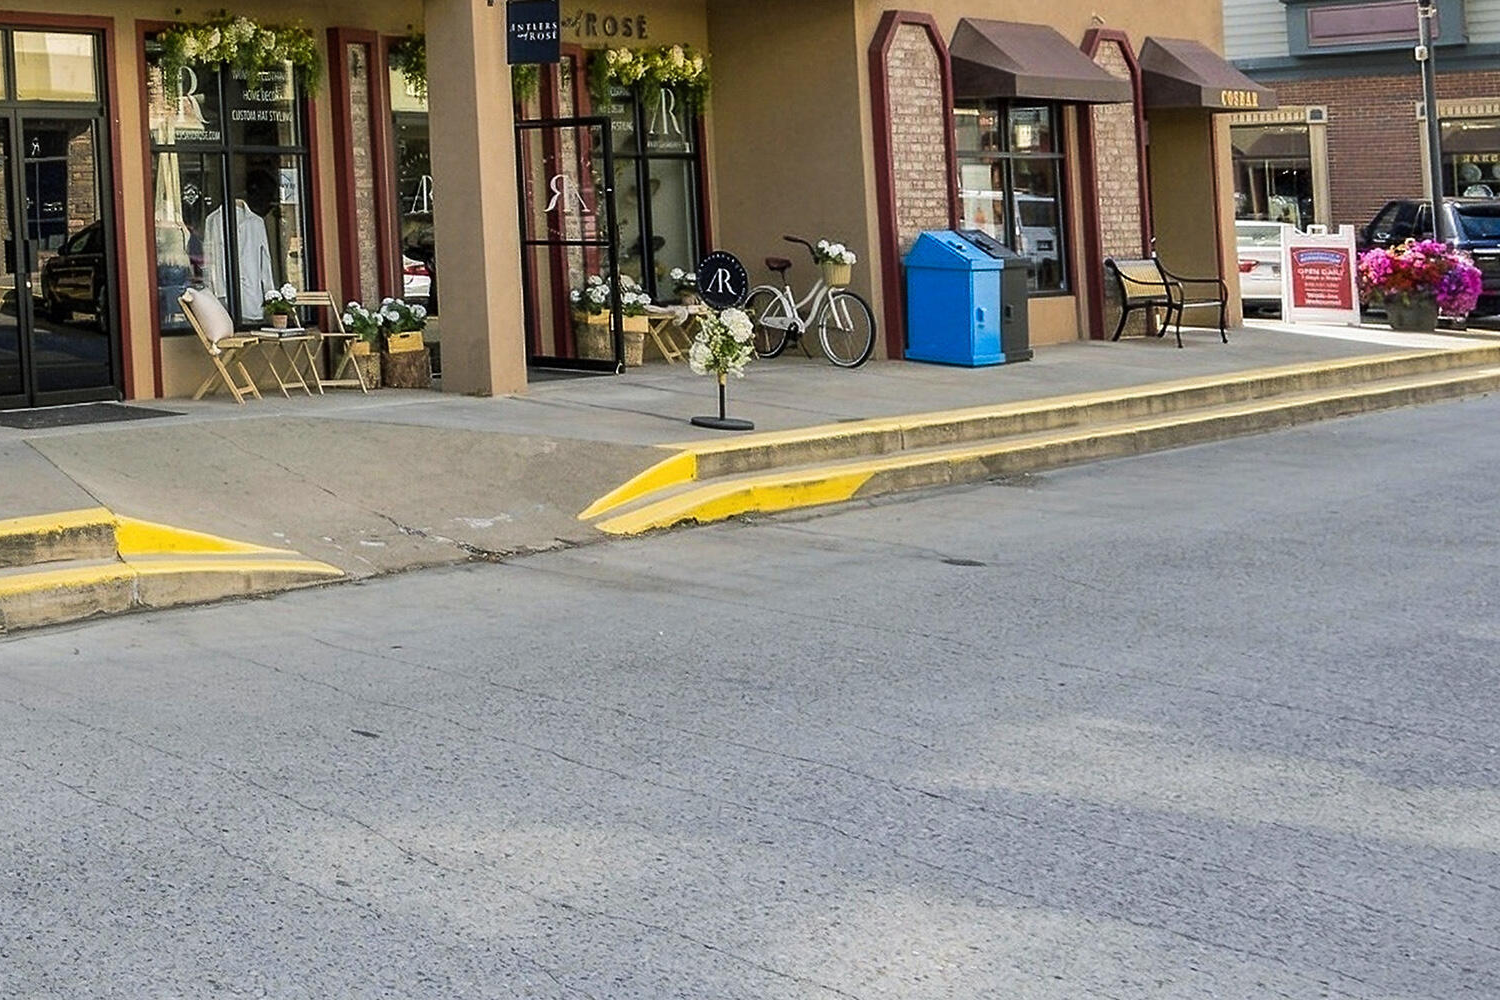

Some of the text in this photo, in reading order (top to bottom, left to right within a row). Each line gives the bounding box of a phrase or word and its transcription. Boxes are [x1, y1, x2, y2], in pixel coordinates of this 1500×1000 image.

[509, 21, 557, 32] ANTLERS
[231, 109, 293, 122] CUSTOM HAT STYLING
